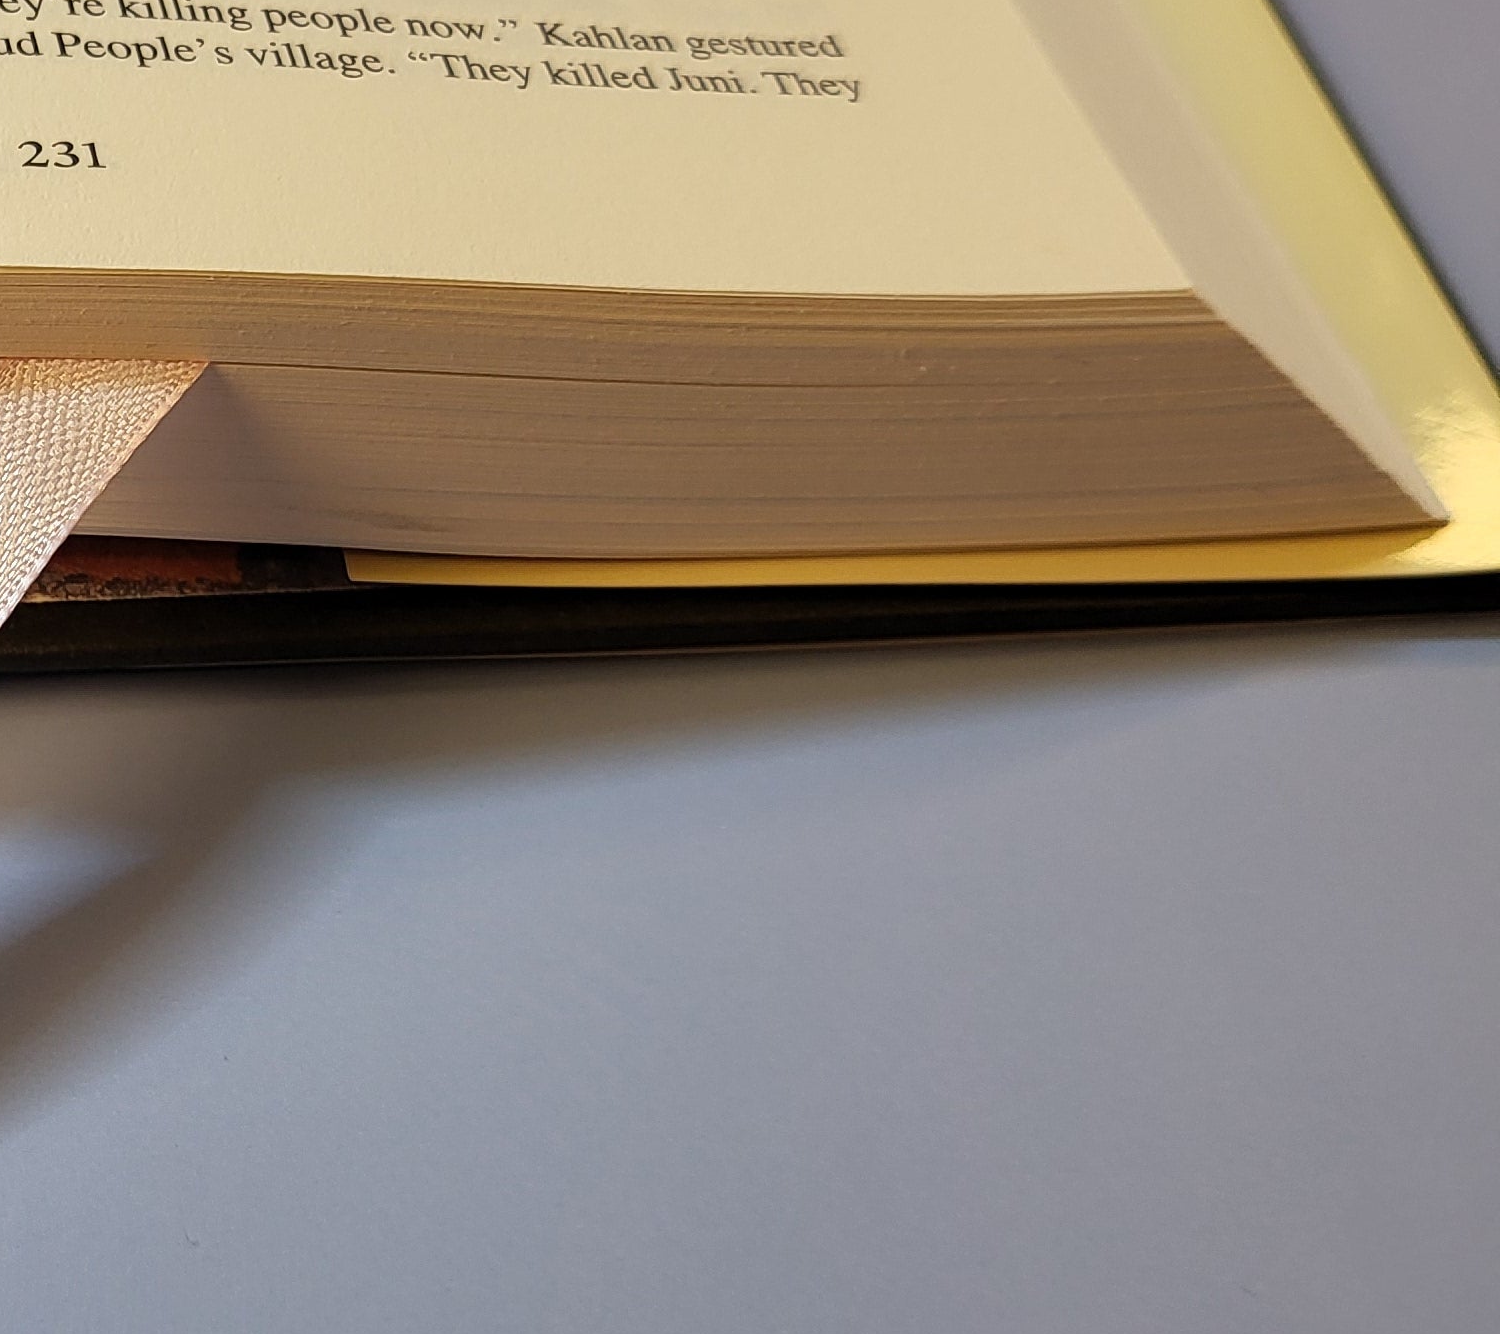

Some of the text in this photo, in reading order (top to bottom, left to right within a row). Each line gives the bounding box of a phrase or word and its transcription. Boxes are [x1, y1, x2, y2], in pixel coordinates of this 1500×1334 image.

[261, 7, 395, 36] people
[535, 21, 678, 54] Kahlan
[686, 34, 846, 59] gestured
[246, 43, 396, 78] village.
[541, 60, 660, 90] killed
[666, 67, 757, 94] Juni.
[761, 71, 862, 103] They
[18, 141, 107, 169] 231
